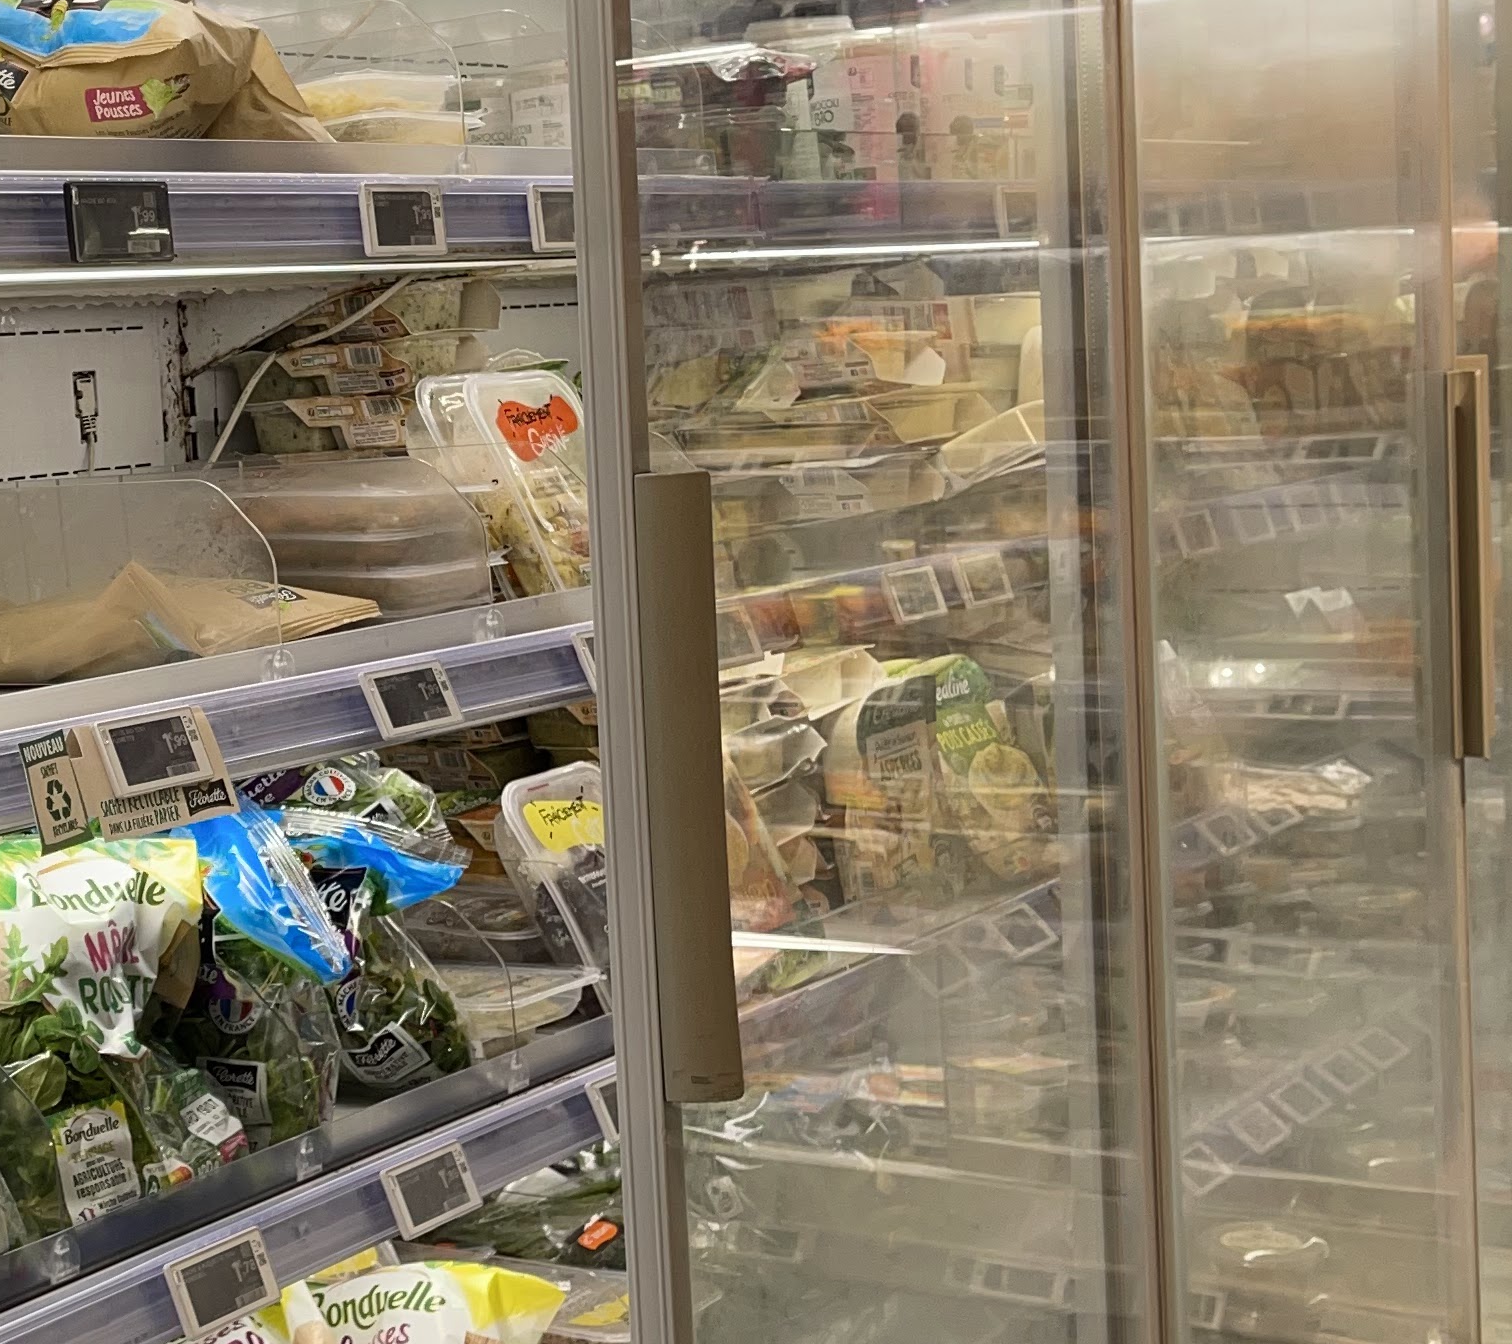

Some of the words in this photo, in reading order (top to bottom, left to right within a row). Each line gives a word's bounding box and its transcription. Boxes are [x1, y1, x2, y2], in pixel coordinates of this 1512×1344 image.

[92, 89, 136, 106] Jeunes
[95, 103, 145, 120] Pousses
[936, 676, 970, 701] ealine
[22, 737, 64, 762] NOUVEAU
[189, 788, 228, 808] Florette
[108, 820, 123, 836] DANS
[153, 806, 181, 825] PAPIER
[213, 1065, 255, 1085] Florette
[63, 1116, 119, 1145] Bonduelle
[73, 1157, 125, 1188] AGRICULTURE
